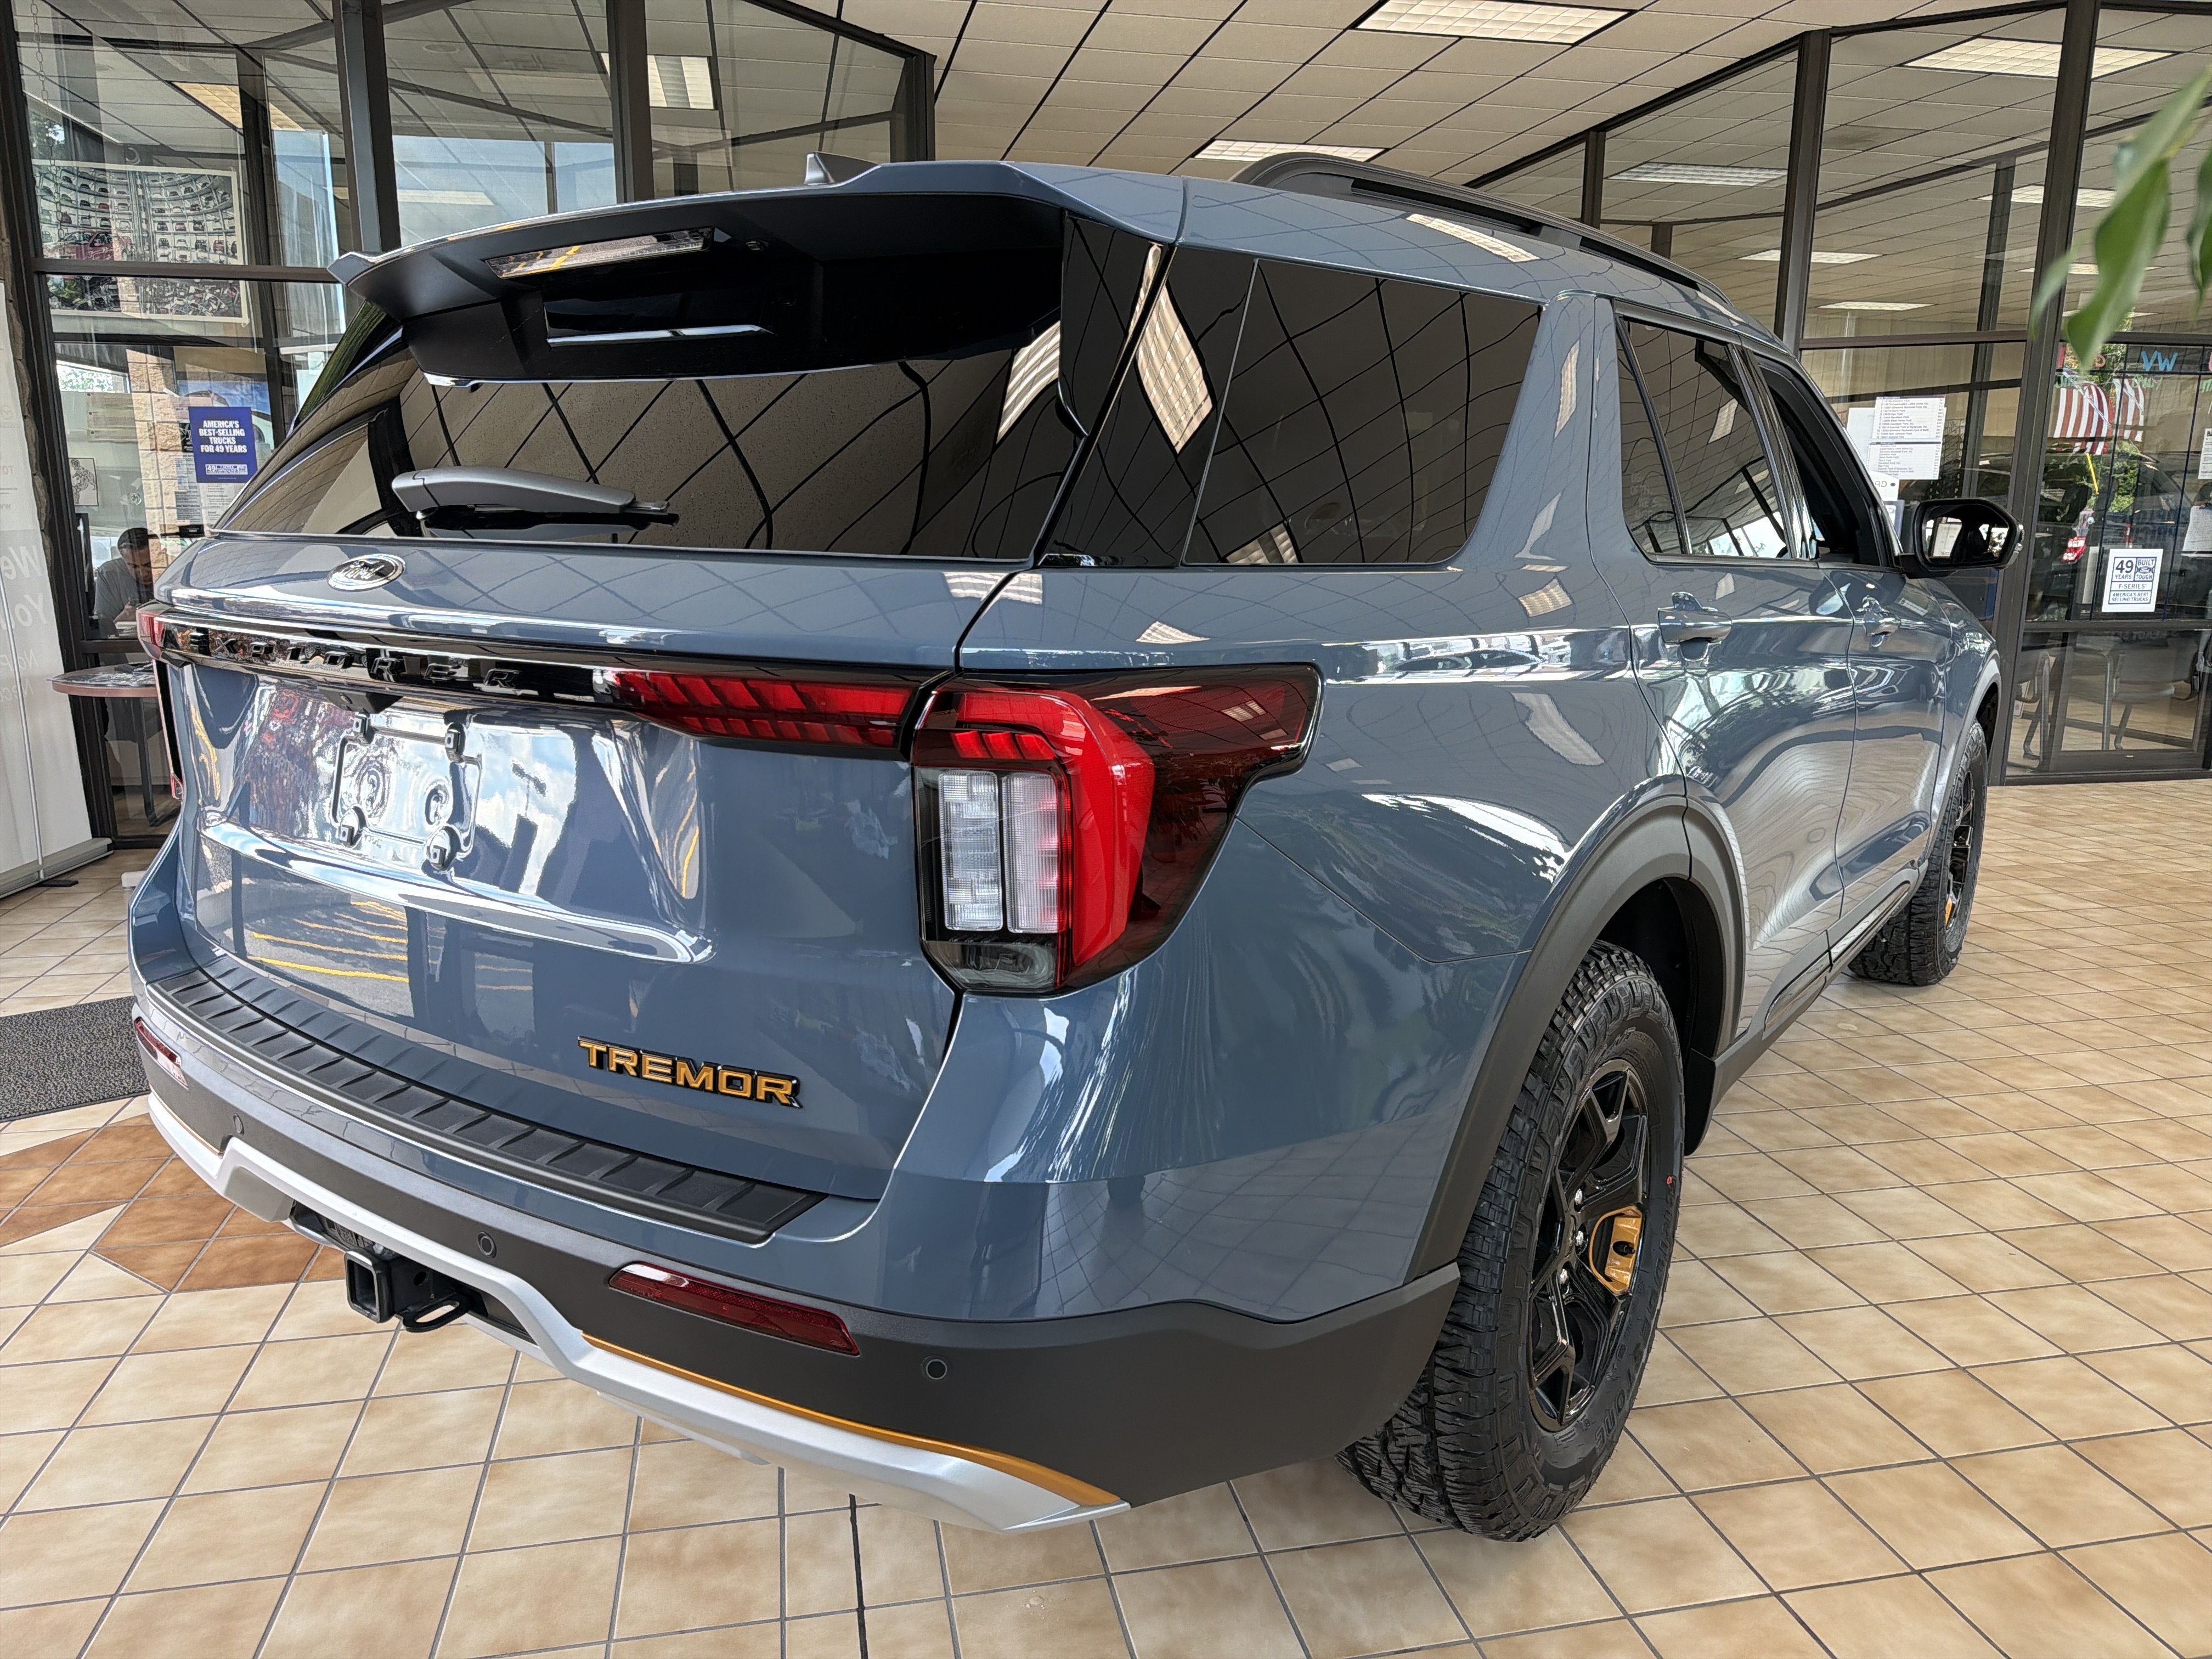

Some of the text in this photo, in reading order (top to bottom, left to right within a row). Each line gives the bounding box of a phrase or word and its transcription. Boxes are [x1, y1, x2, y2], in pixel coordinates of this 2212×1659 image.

[2141, 350, 2179, 371] VW
[203, 420, 240, 428] AMERICA'S
[199, 428, 245, 437] BEST-SELLING
[200, 444, 247, 453] FOR 49 YEARS
[2115, 560, 2134, 573] 49
[189, 627, 520, 689] EXPLORER
[578, 1035, 803, 1109] TREMOR
